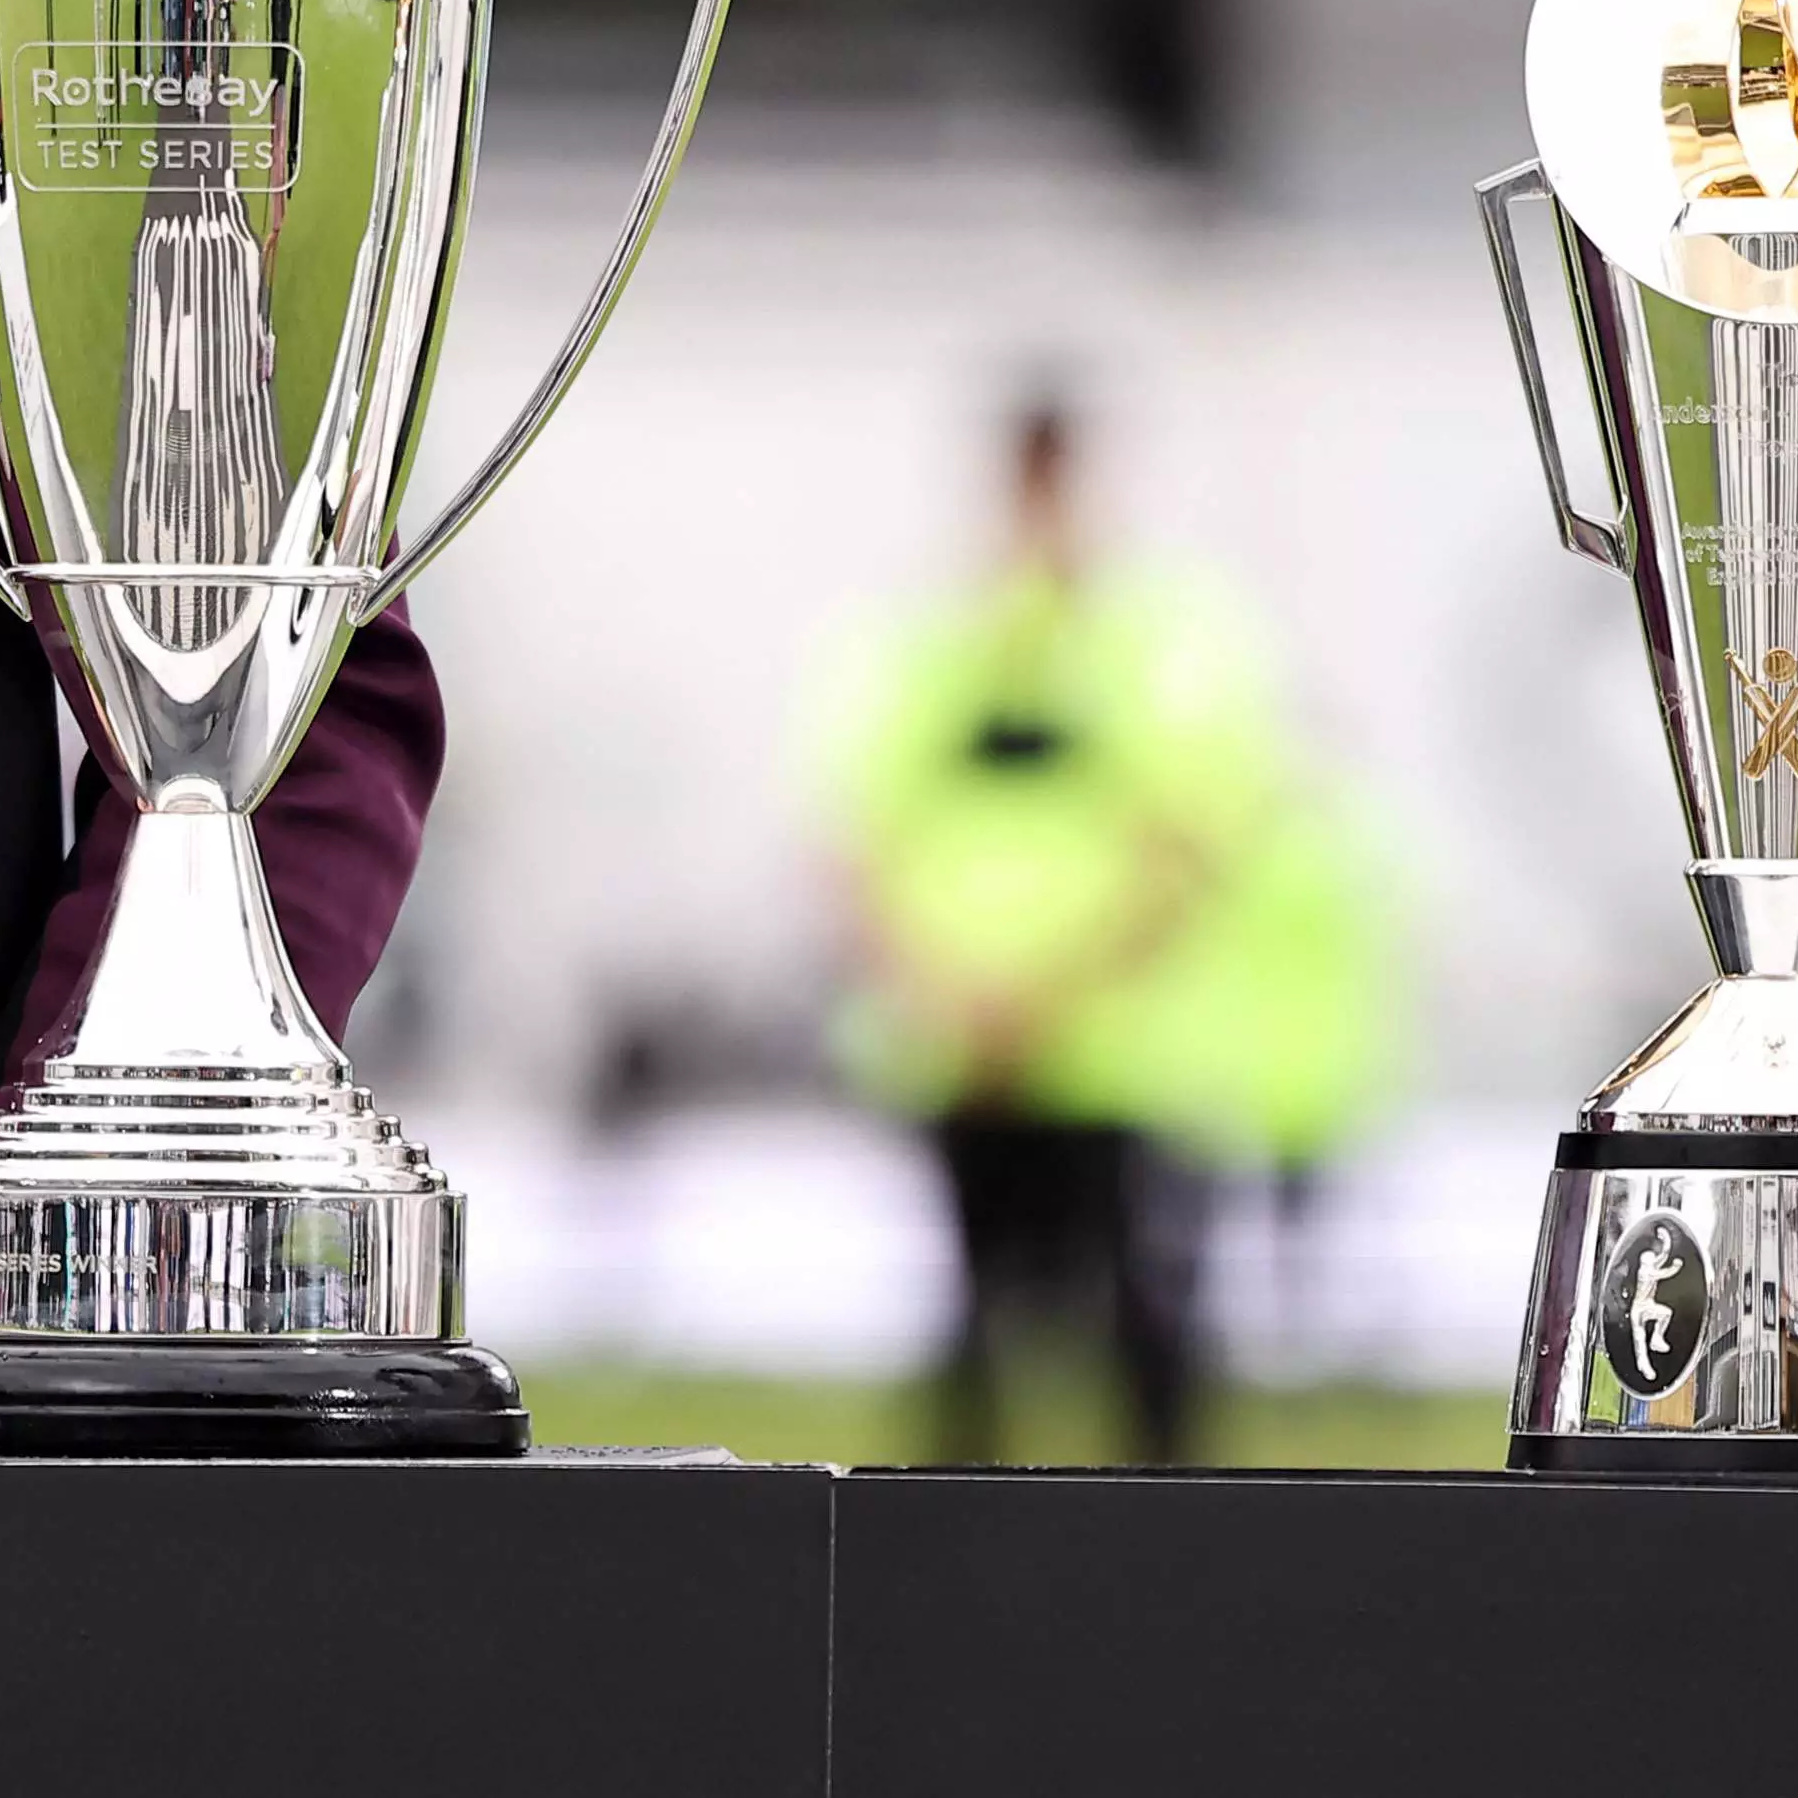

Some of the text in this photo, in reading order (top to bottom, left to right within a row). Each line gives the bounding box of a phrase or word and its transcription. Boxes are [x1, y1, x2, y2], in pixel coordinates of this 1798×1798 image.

[31, 68, 279, 117] Rothesay
[37, 140, 274, 170] TEST SERIES
